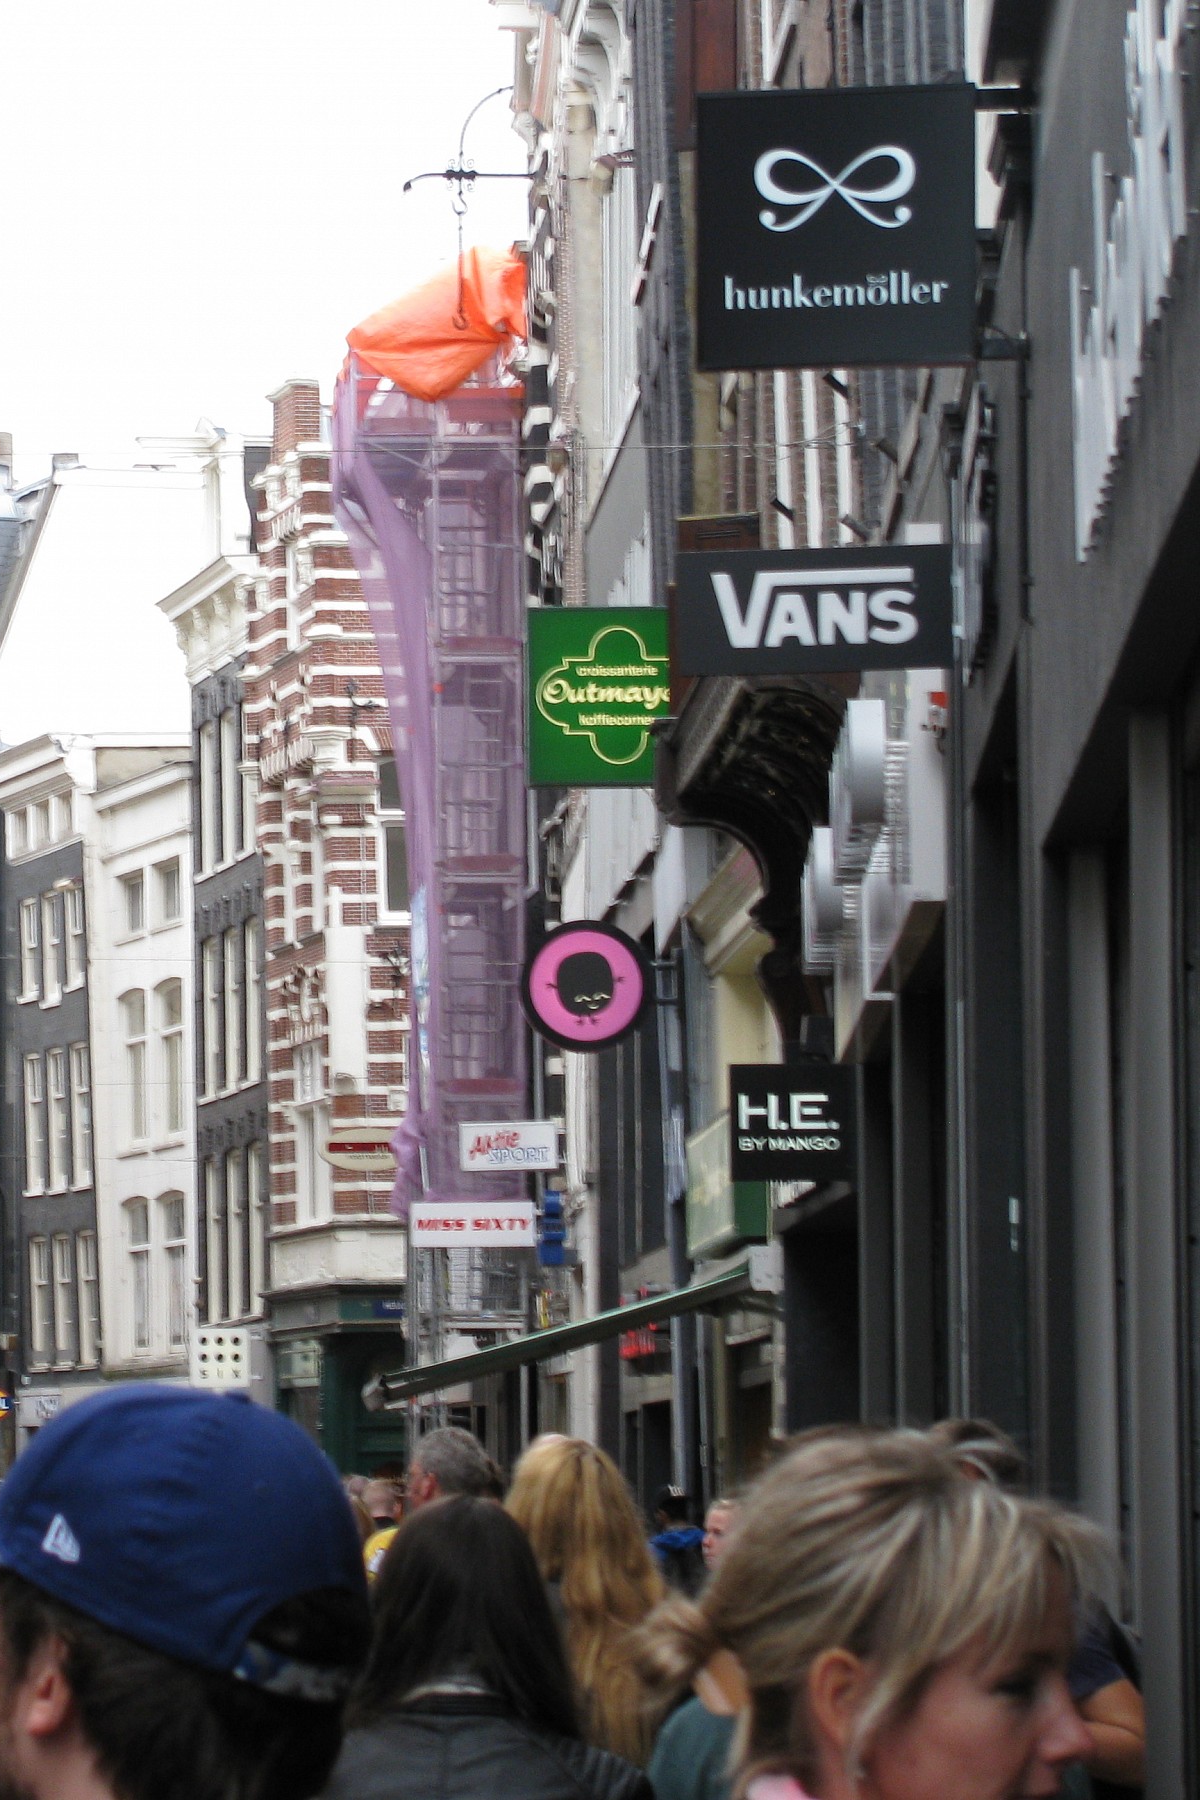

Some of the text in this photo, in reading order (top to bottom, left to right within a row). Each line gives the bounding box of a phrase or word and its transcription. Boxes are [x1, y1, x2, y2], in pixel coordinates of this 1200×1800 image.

[724, 270, 949, 310] hunkemöller
[710, 567, 919, 649] VANS
[738, 1136, 841, 1151] BY MANGO
[416, 1217, 531, 1232] MISS SIXTY
